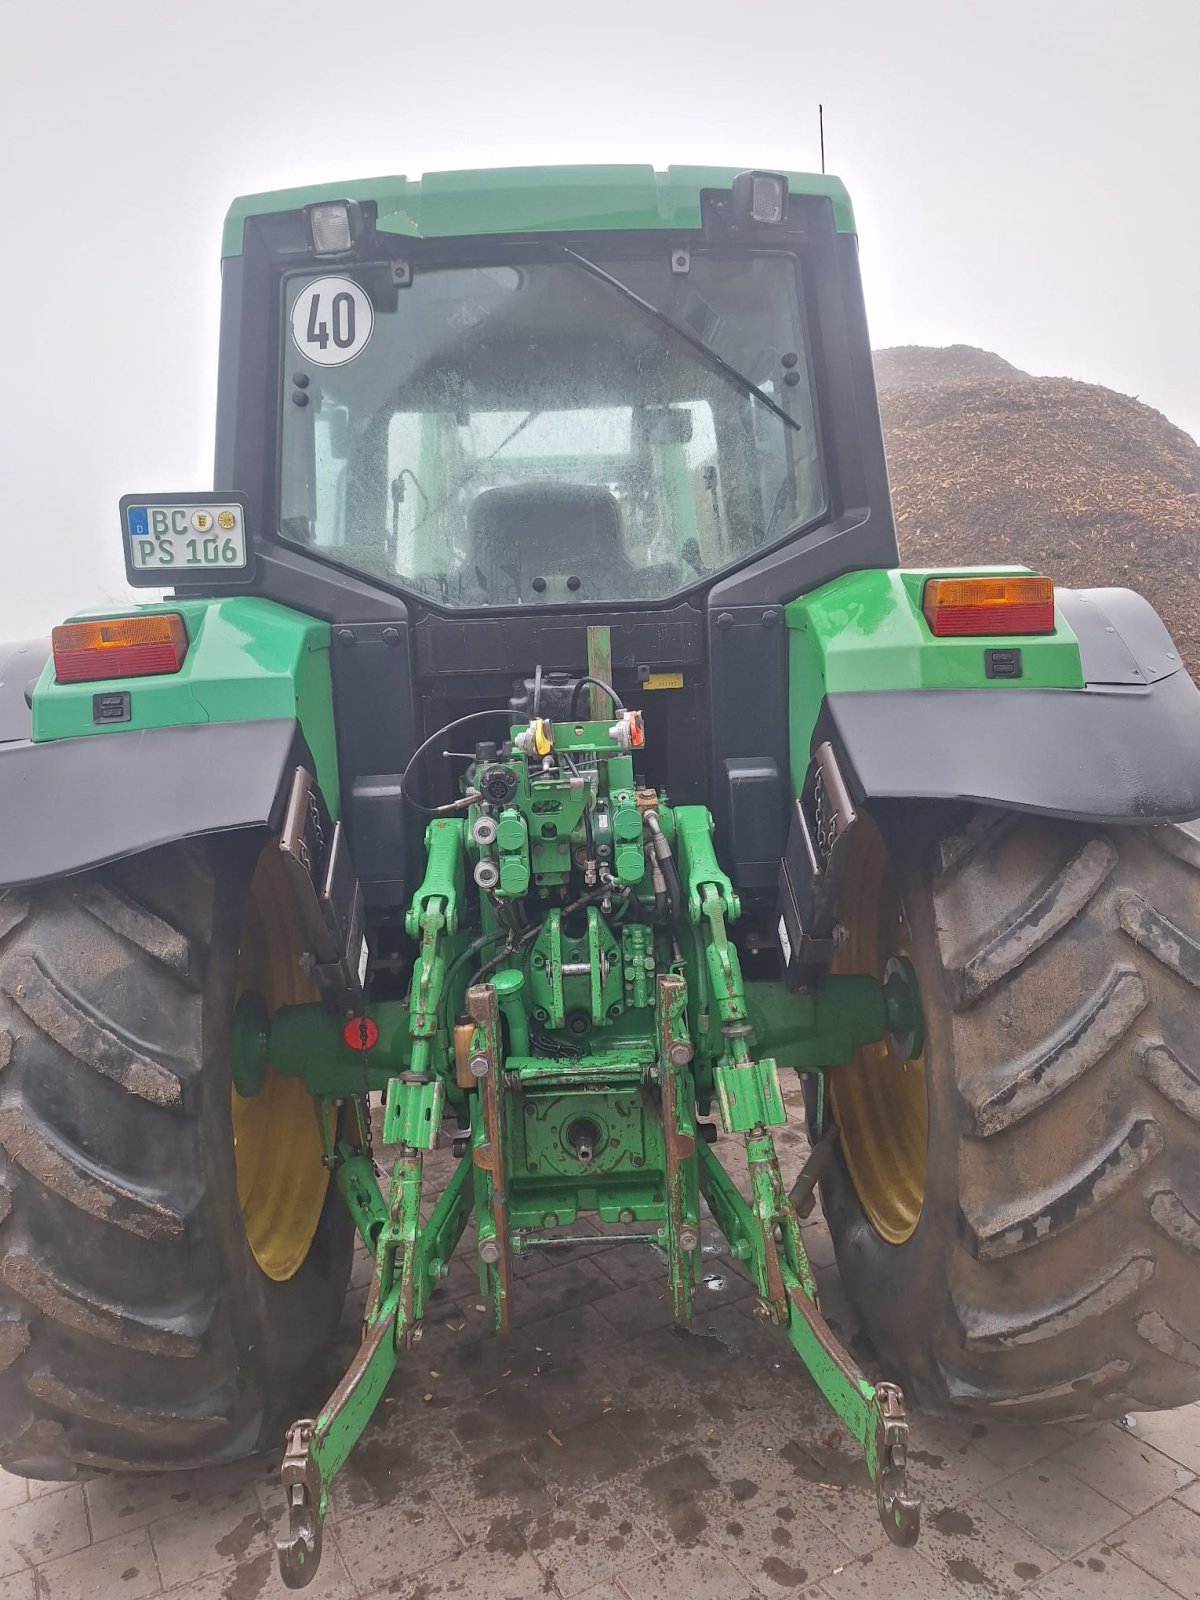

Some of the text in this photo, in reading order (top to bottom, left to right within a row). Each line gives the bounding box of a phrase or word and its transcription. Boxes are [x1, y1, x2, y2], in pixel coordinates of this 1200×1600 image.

[306, 291, 356, 350] 40
[136, 525, 144, 534] D
[152, 510, 188, 536] BC
[138, 537, 238, 566] PS 106
